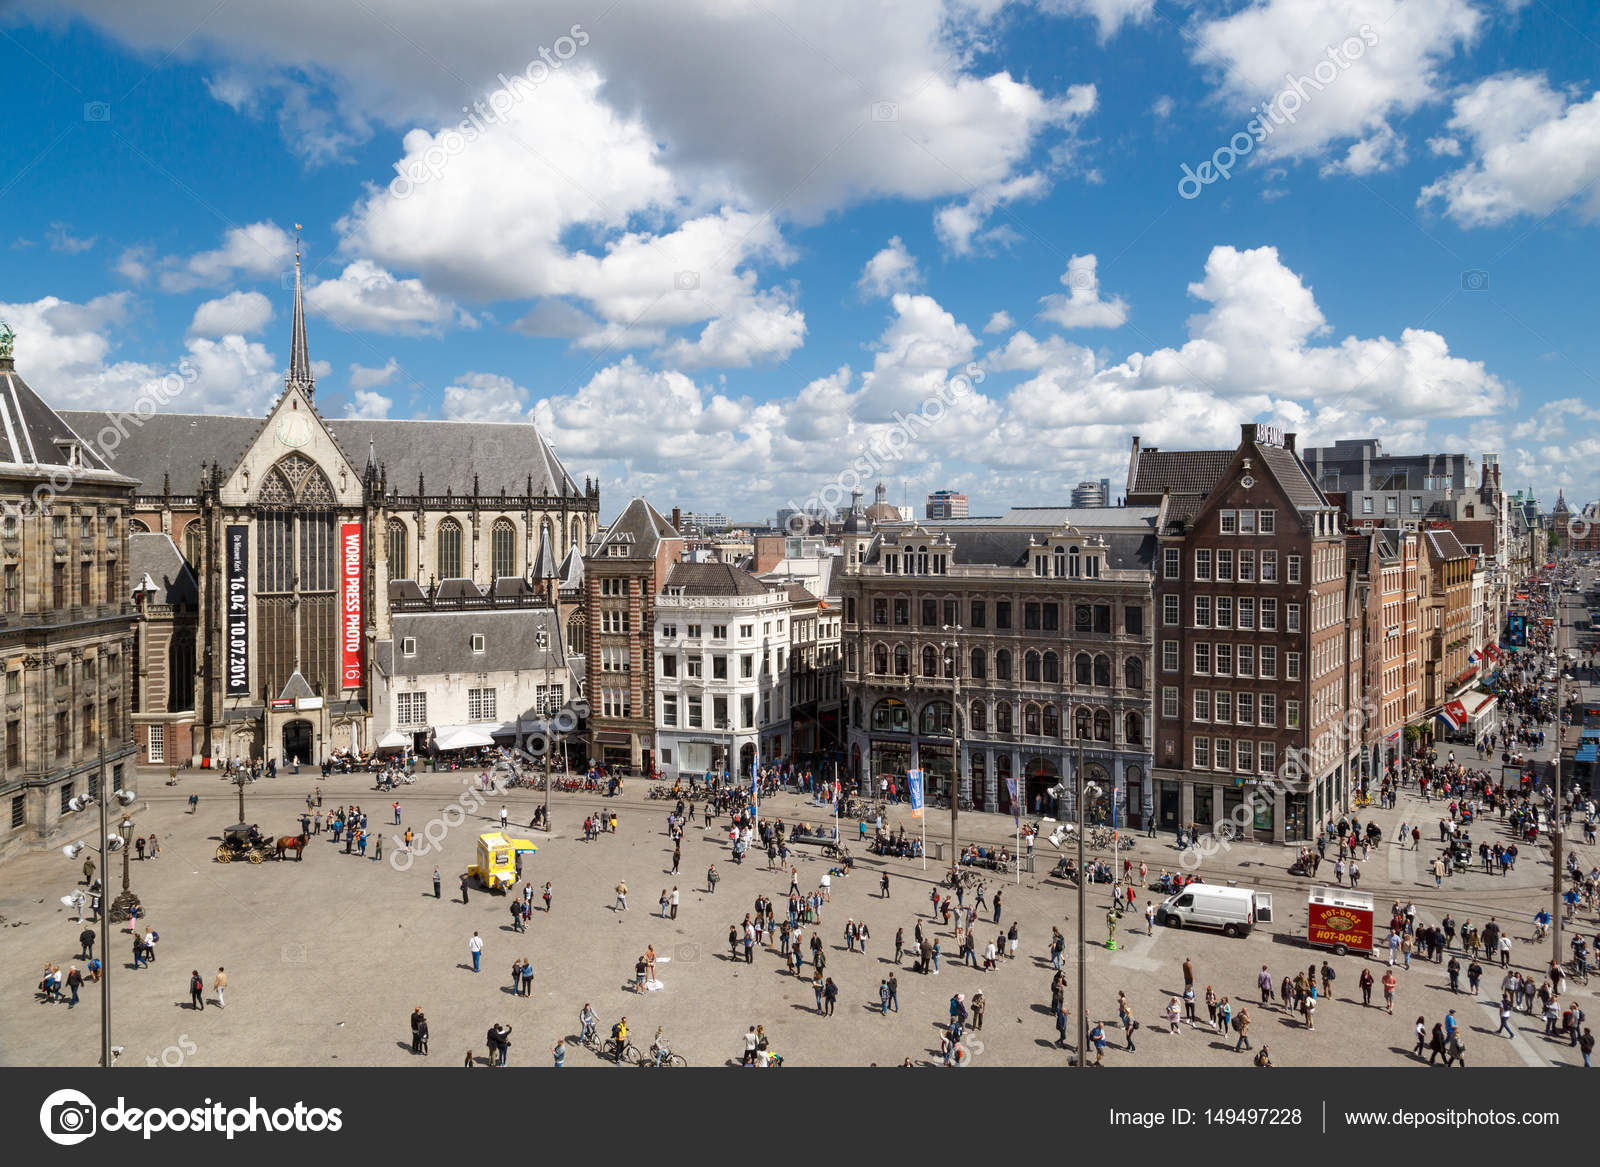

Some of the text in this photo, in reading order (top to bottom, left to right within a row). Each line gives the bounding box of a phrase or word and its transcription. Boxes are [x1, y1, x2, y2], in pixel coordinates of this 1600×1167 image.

[230, 534, 246, 687] De Nieuwe Kerk 16.04 10.07.2016
[345, 533, 361, 680] WORLD PRESS PHOTO 16
[1316, 930, 1363, 944] HOT-DOGS
[1320, 908, 1361, 924] HOT-DOGS
